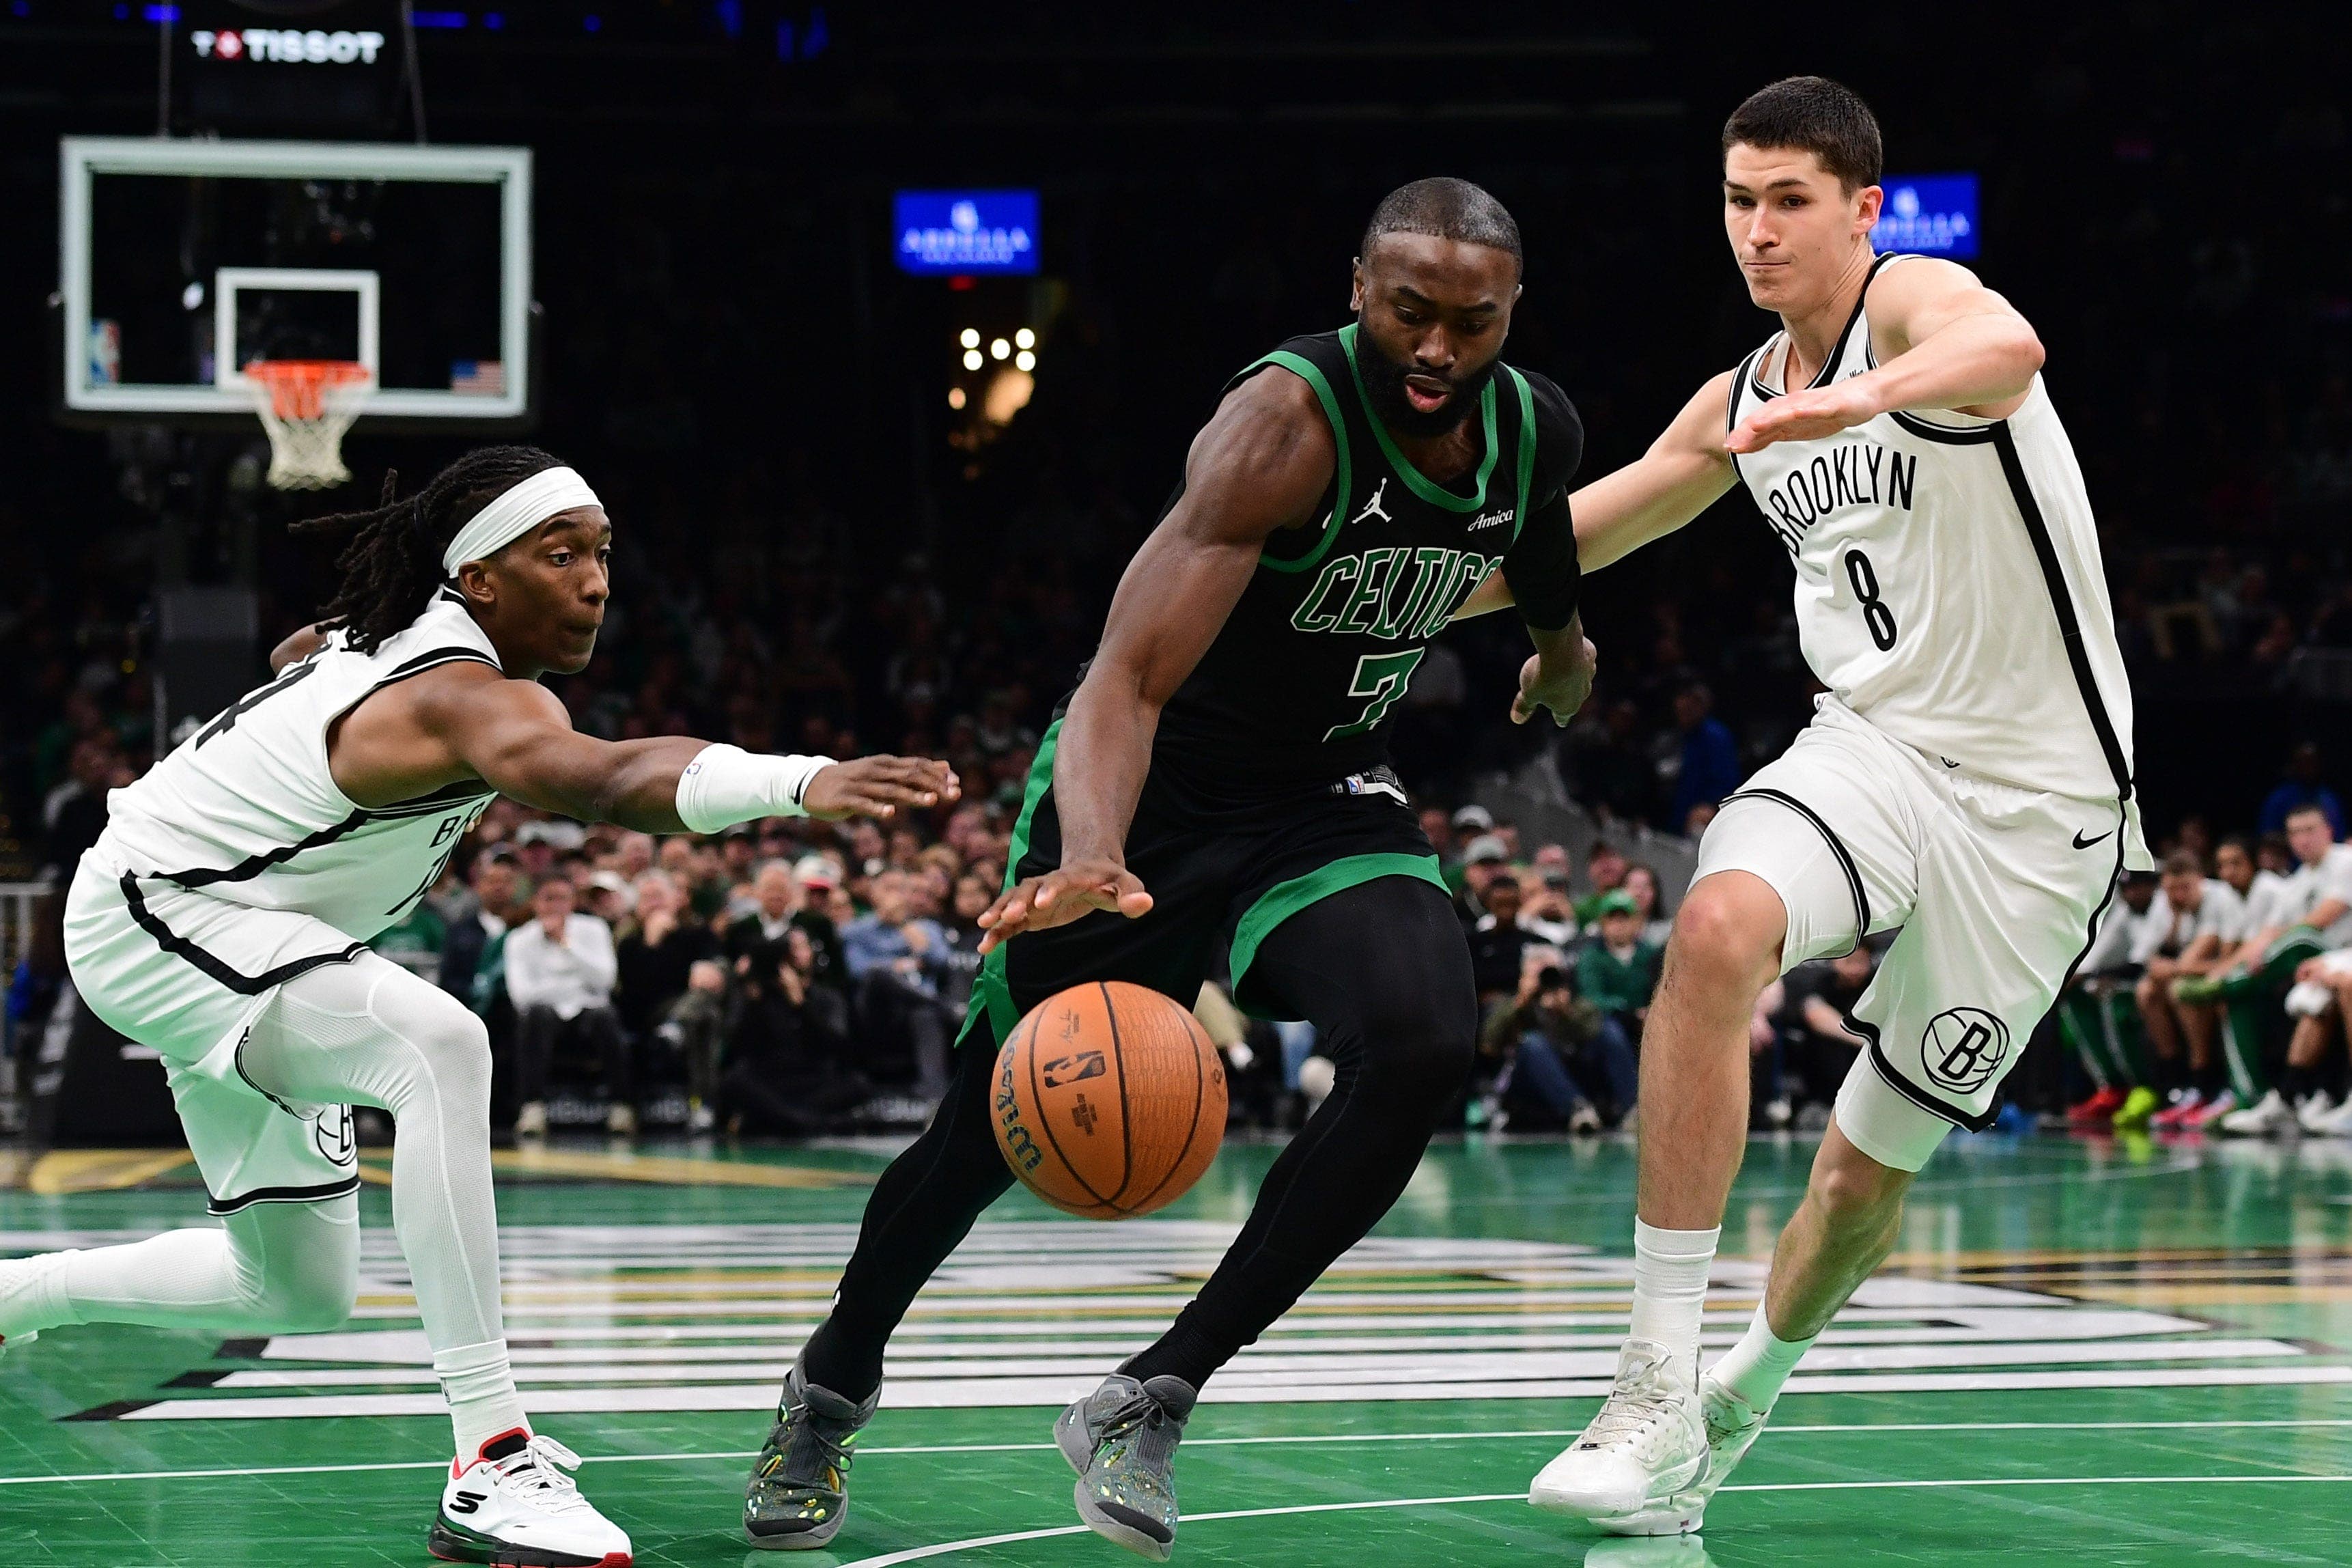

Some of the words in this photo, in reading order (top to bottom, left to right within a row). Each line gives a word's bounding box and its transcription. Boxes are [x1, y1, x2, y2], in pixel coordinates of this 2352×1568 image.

[242, 28, 385, 64] TISSOT
[1468, 509, 1513, 531] Amica
[1764, 444, 1917, 558] BROOKLYN
[1844, 548, 1898, 652] 8
[1321, 646, 1426, 743] 7
[1937, 1021, 1991, 1080] B
